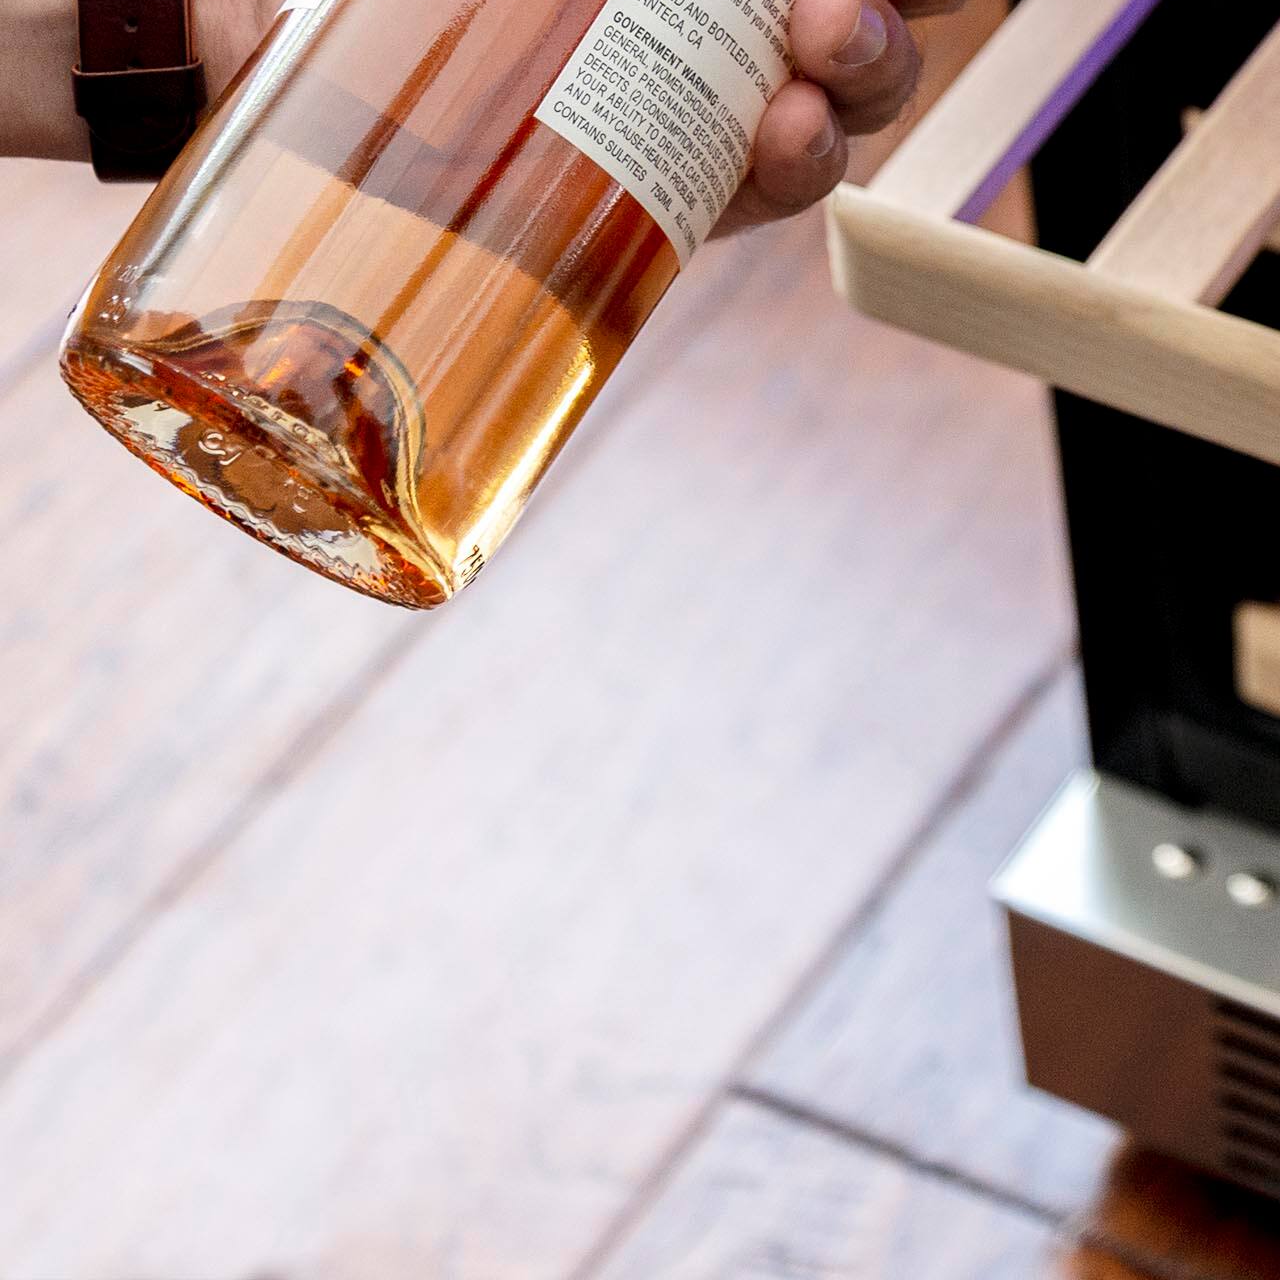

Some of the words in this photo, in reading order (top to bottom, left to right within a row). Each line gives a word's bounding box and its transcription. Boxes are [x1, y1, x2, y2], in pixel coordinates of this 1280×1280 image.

[613, 10, 683, 70] GOVERNMENT
[681, 64, 720, 109] WARNING:
[684, 2, 710, 27] AND
[707, 20, 750, 67] BOTTLED
[744, 60, 760, 79] BY
[687, 29, 705, 51] CA
[741, 0, 754, 18] for
[749, 13, 766, 31] you
[563, 82, 591, 106] AND
[592, 101, 618, 126] MAY
[614, 119, 646, 151] CAUSE
[641, 143, 672, 177] HEALTH
[575, 66, 608, 98] YOUR
[606, 92, 647, 128] ABILITY
[645, 122, 660, 141] TO
[657, 135, 684, 166] DRIVE
[583, 52, 631, 95] DEFECTS.
[629, 88, 644, 106] (2)
[642, 98, 696, 158] CONSUMPTION
[691, 147, 704, 161] OF
[592, 38, 639, 78] DURING
[638, 72, 696, 129] PREGNANCY
[692, 123, 724, 164] BECAUSE
[603, 24, 651, 68] GENERAL,
[651, 60, 686, 97] WOMEN
[683, 89, 713, 124] SHOULD
[709, 118, 724, 138] NOT
[553, 100, 607, 145] CONTAINS
[604, 140, 648, 182] SULFITES
[650, 181, 673, 212] 750ML
